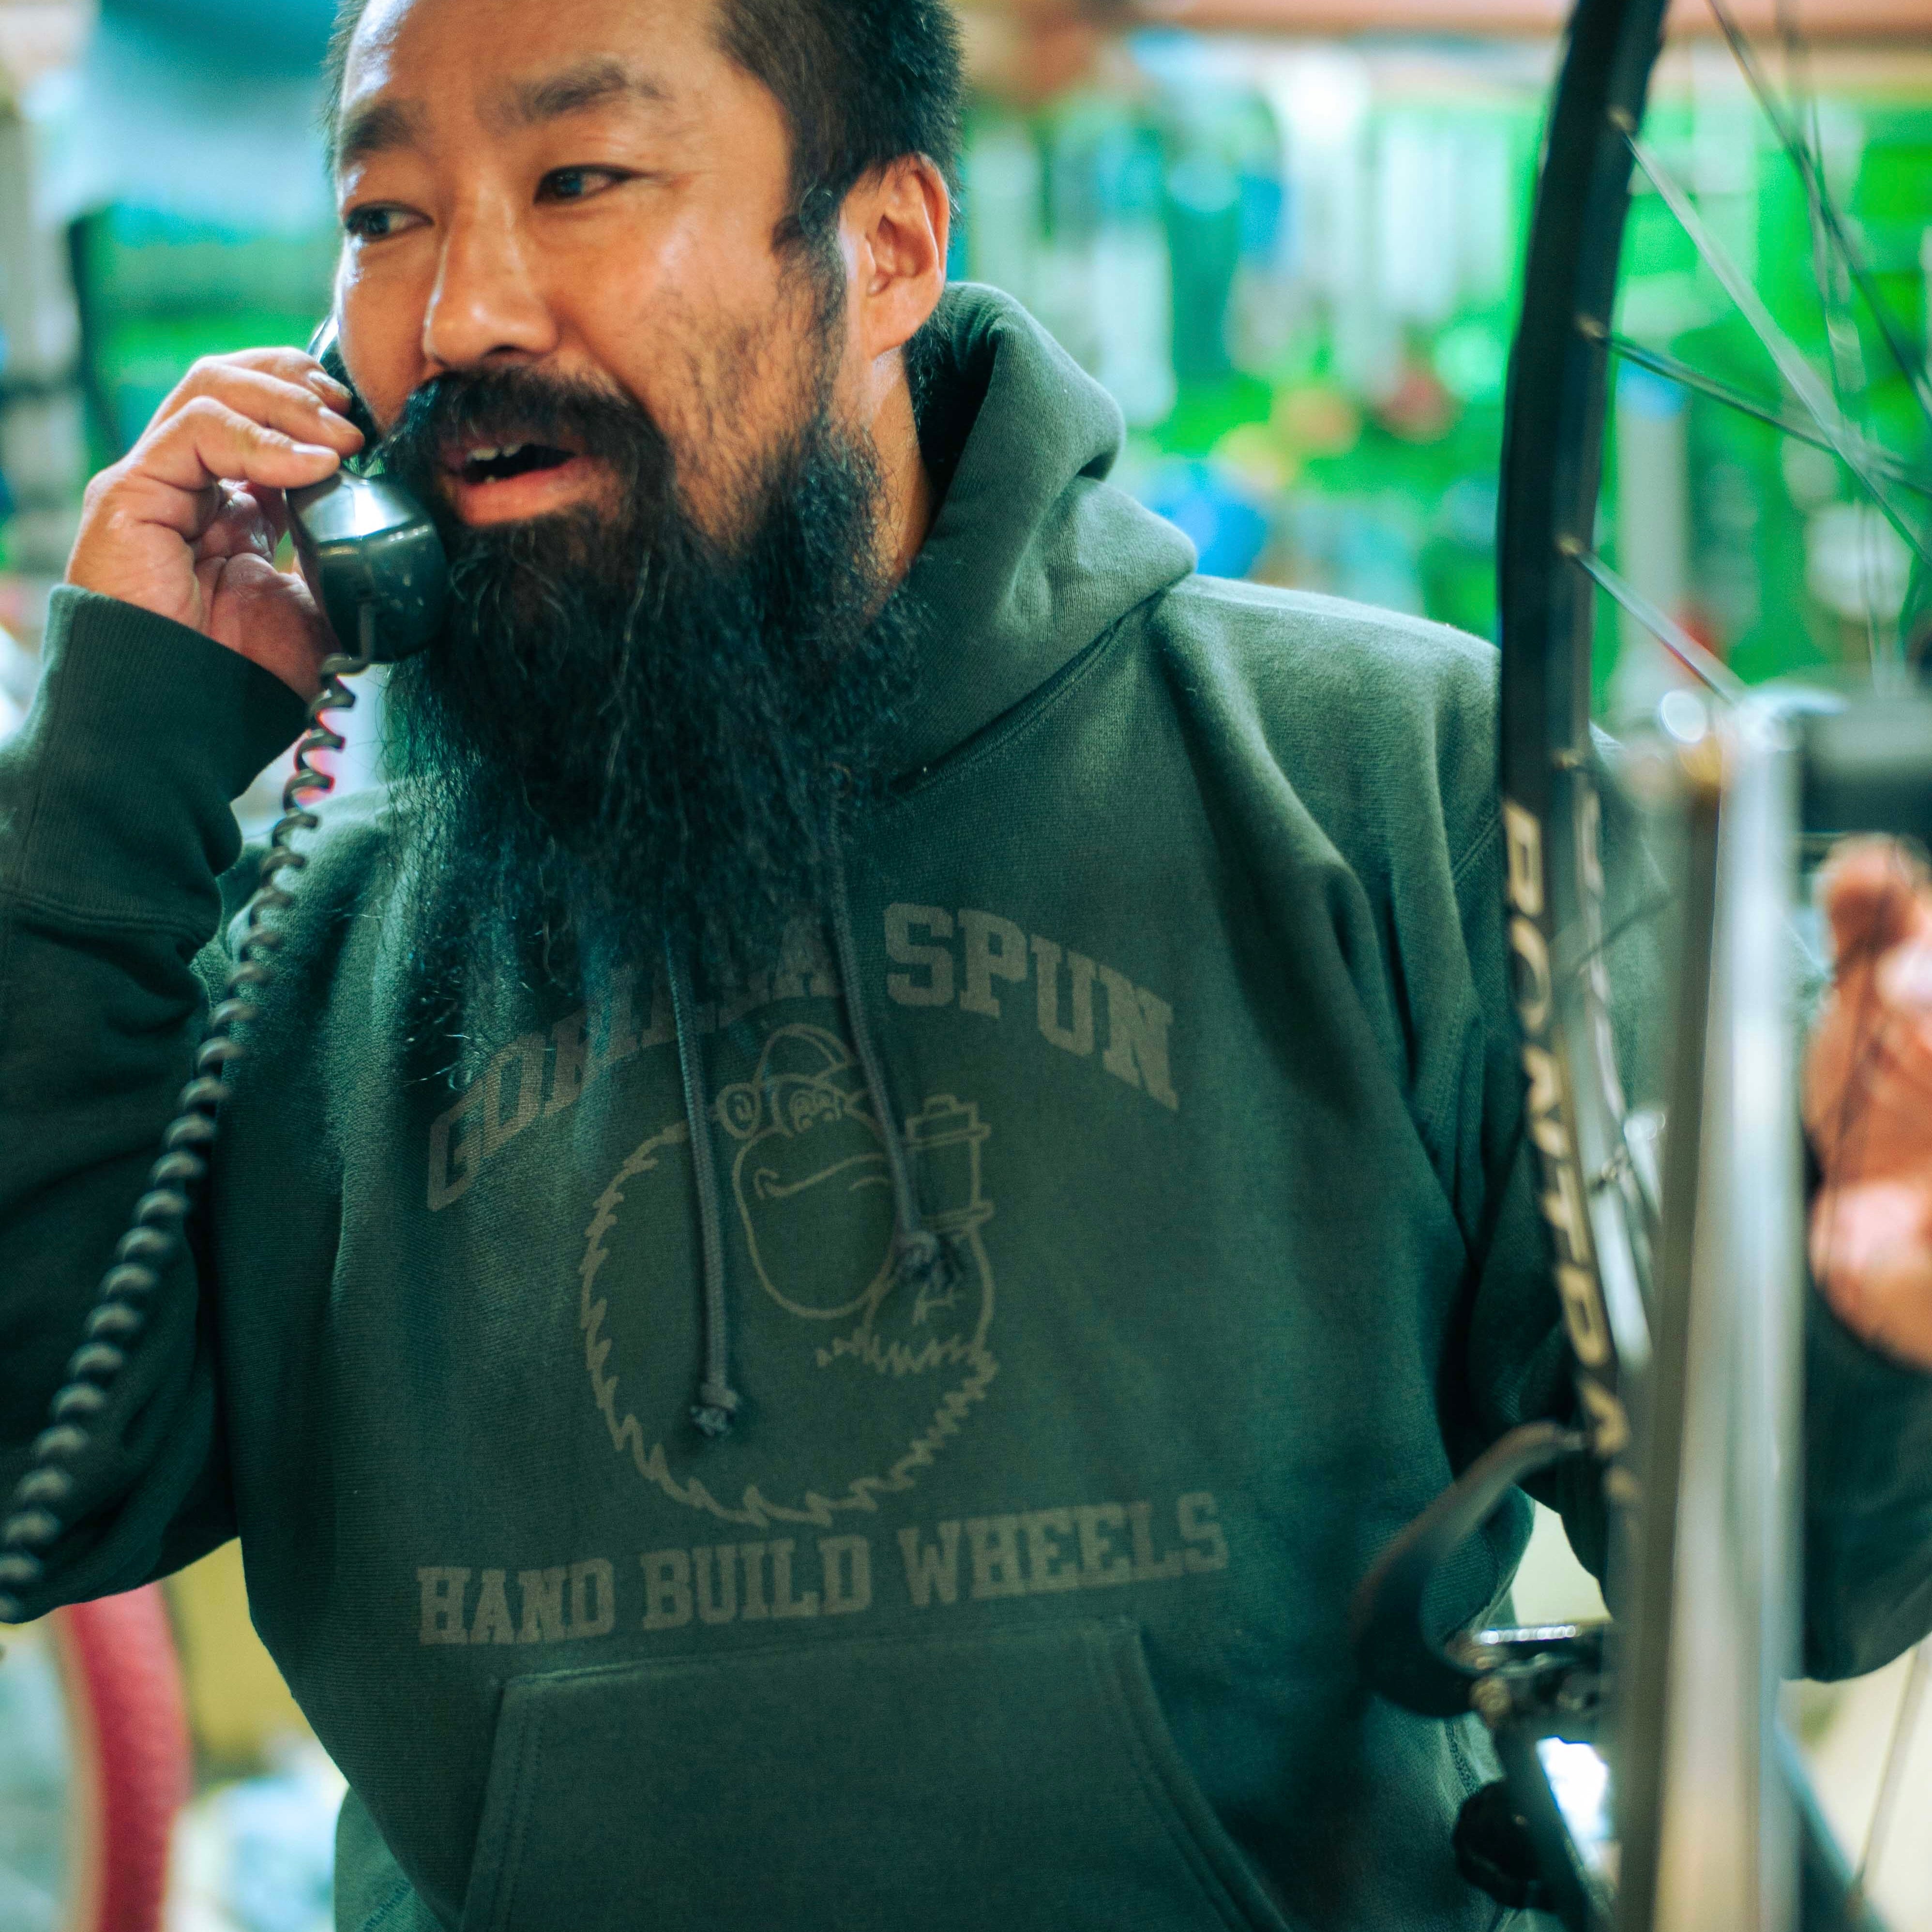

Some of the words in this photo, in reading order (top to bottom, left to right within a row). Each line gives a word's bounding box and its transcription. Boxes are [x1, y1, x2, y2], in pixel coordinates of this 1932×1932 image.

[427, 907, 842, 1212] GORILA
[883, 902, 1179, 1111] SPUN
[1501, 798, 1643, 1504] BONTRA
[416, 1557, 615, 1645] HAND
[639, 1535, 871, 1631] BUILD
[897, 1492, 1229, 1608] WHEELS
